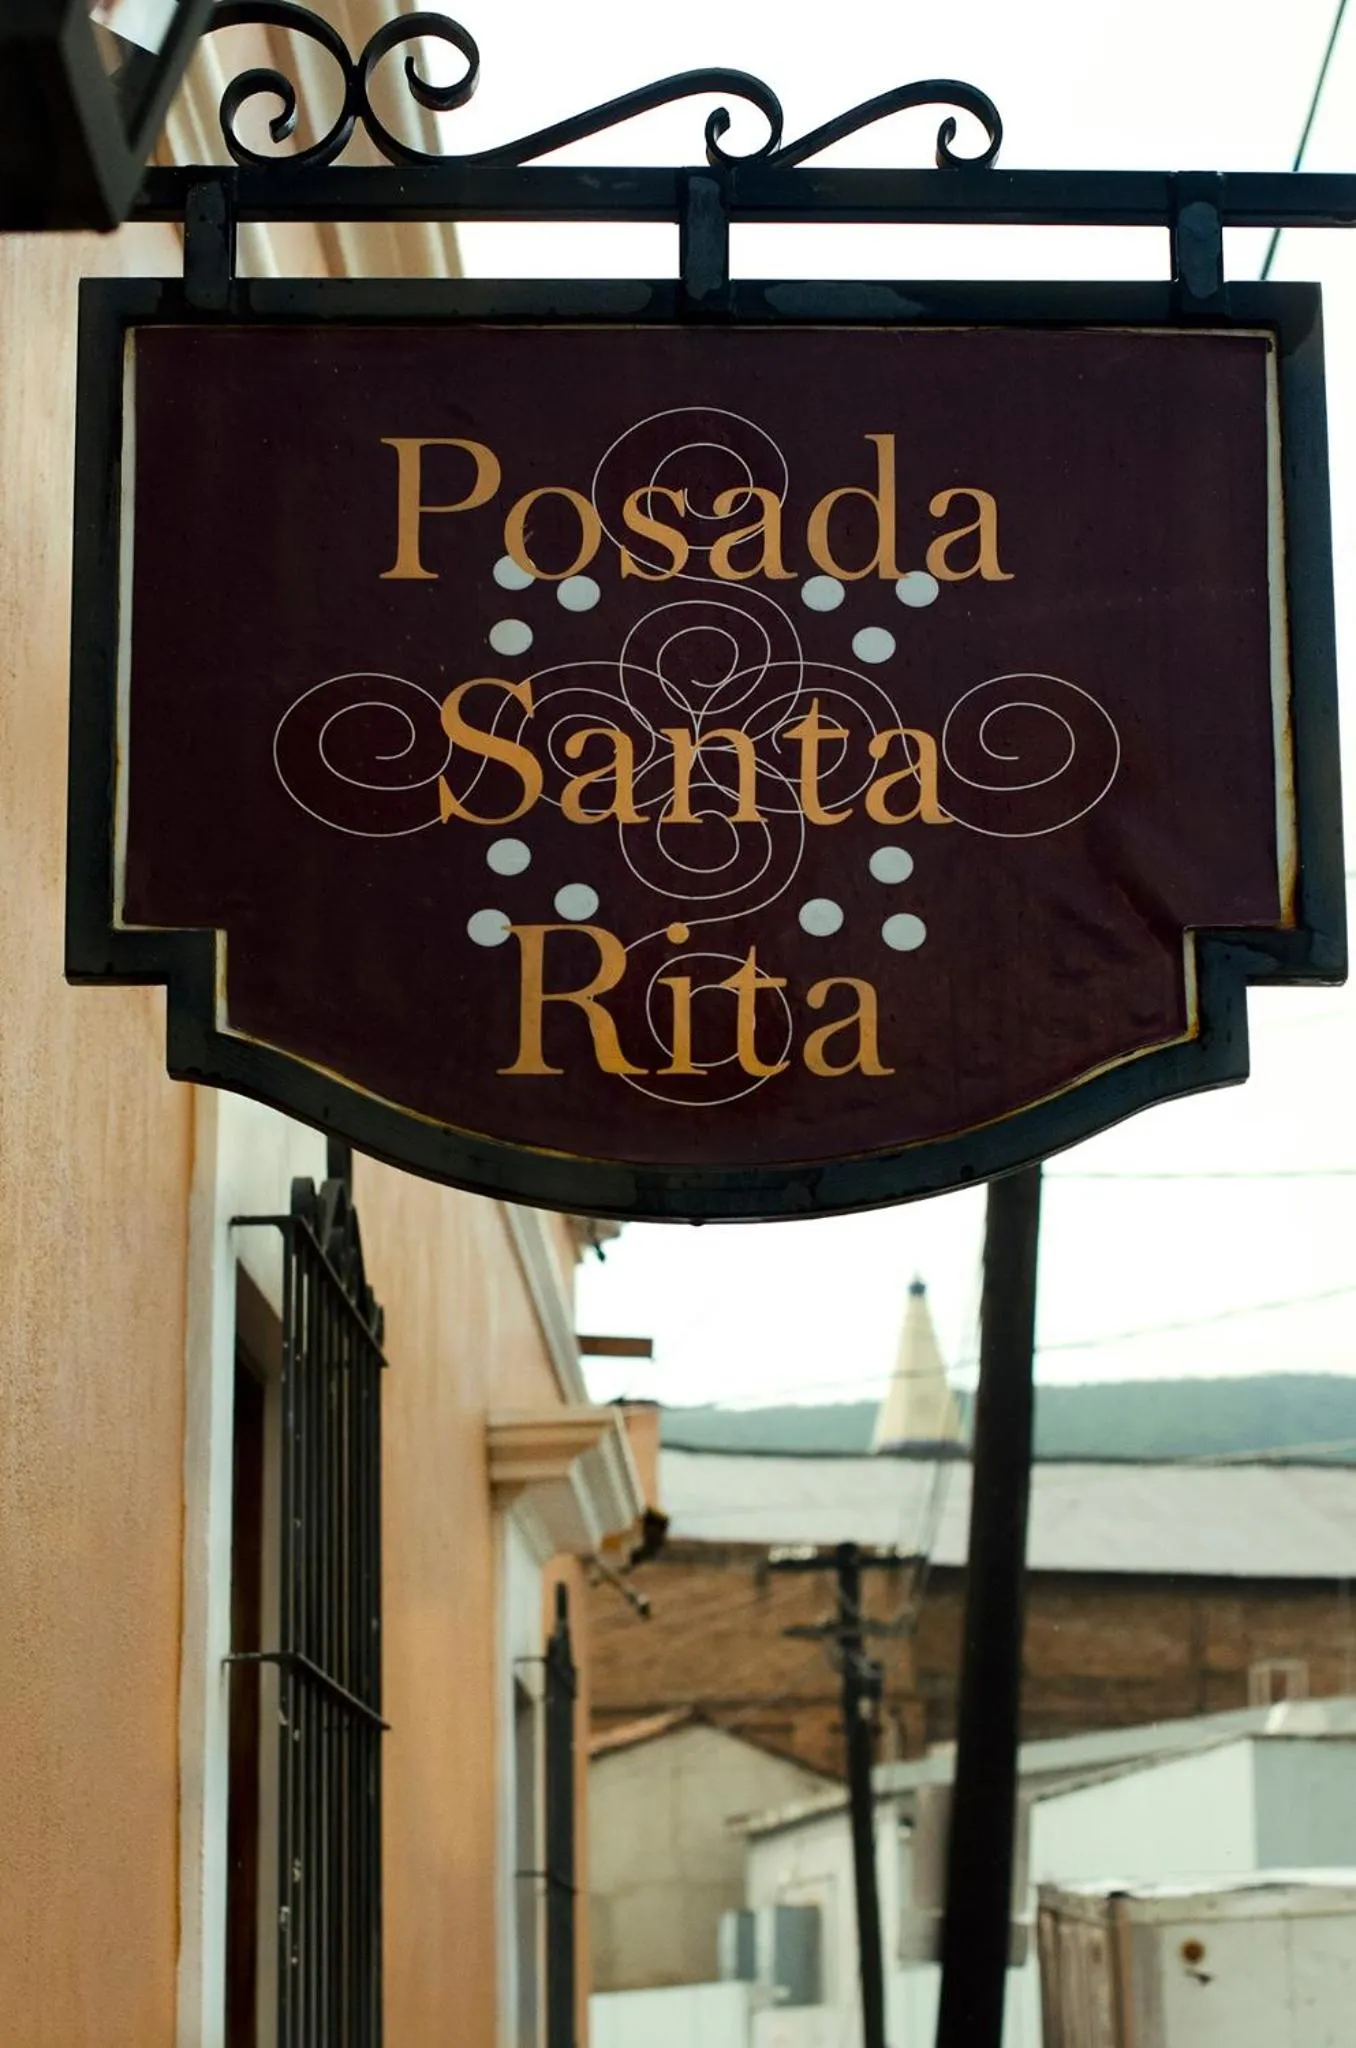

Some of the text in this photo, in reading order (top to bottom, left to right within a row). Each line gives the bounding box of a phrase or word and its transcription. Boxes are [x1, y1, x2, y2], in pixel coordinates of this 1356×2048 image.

[379, 433, 1014, 582] Posada
[436, 677, 956, 827] Santa
[496, 922, 896, 1078] Rita
